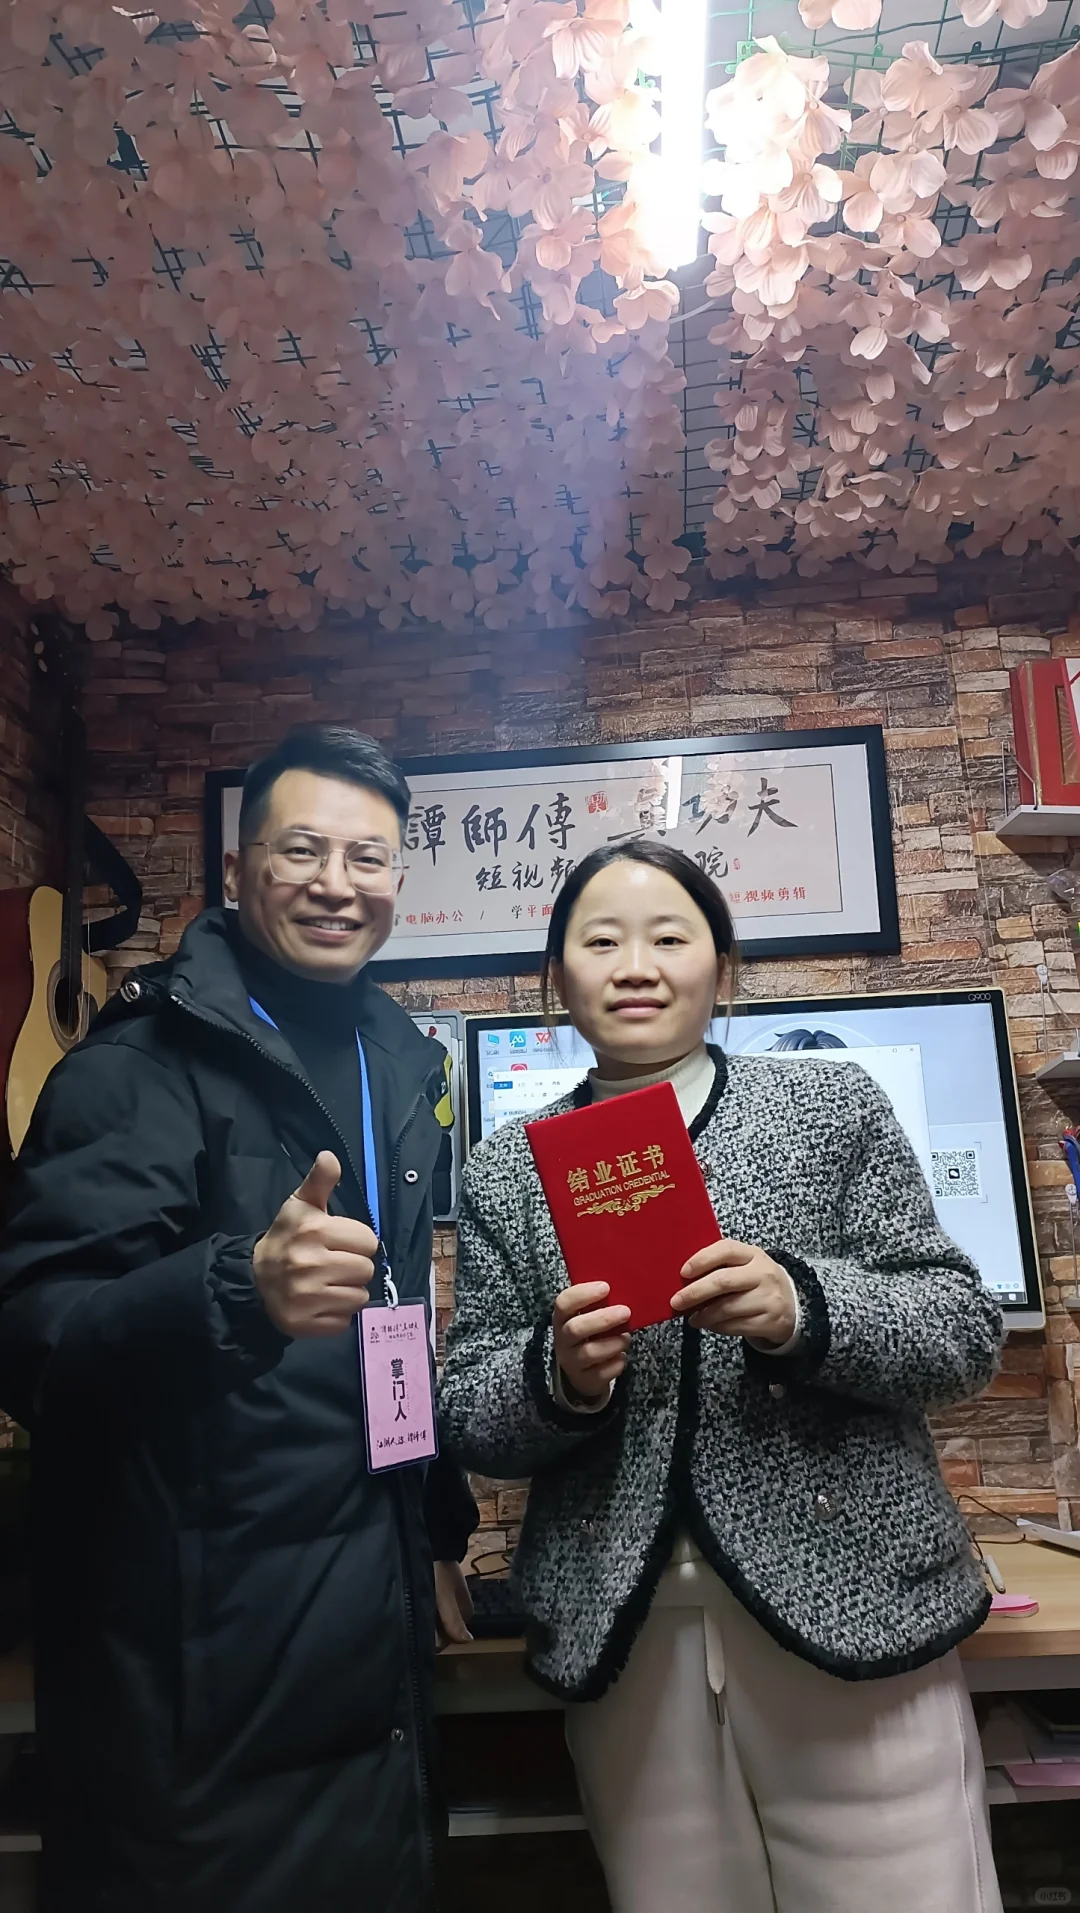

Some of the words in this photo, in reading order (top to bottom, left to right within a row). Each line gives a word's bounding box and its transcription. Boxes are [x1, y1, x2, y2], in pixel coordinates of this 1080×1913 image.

[729, 886, 806, 905] 短视频剪辑
[968, 992, 991, 1001] Q900
[567, 1144, 665, 1194] 结业证书
[573, 1184, 623, 1206] GRADUATION
[623, 1170, 670, 1190] CREDENTIAL
[390, 1358, 407, 1422] 掌门人
